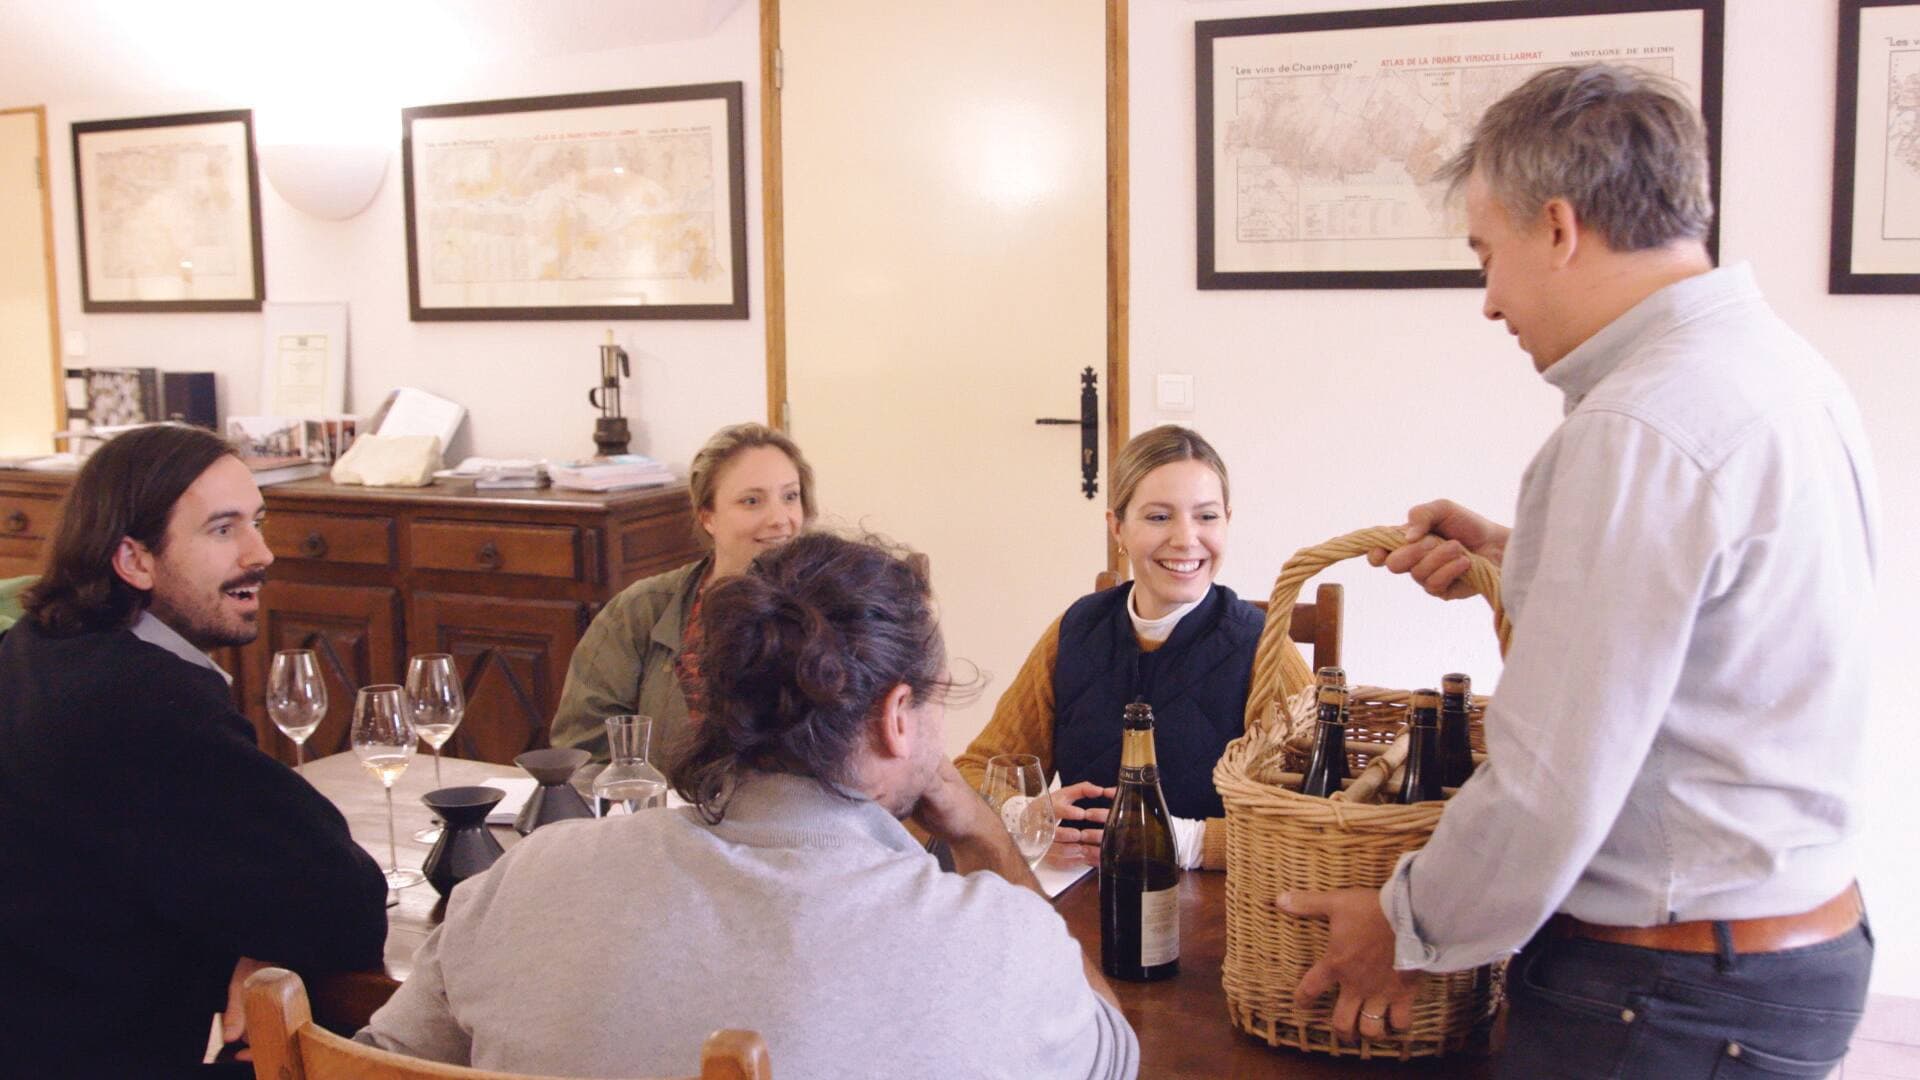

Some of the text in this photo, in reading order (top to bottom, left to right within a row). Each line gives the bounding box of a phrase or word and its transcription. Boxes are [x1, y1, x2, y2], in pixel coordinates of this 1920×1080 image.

[1380, 56, 1405, 67] ATLAS
[1408, 56, 1417, 66] DE
[1418, 55, 1429, 65] LA
[1431, 54, 1462, 65] FRANCE
[1255, 64, 1275, 74] vins
[1278, 63, 1290, 73] de
